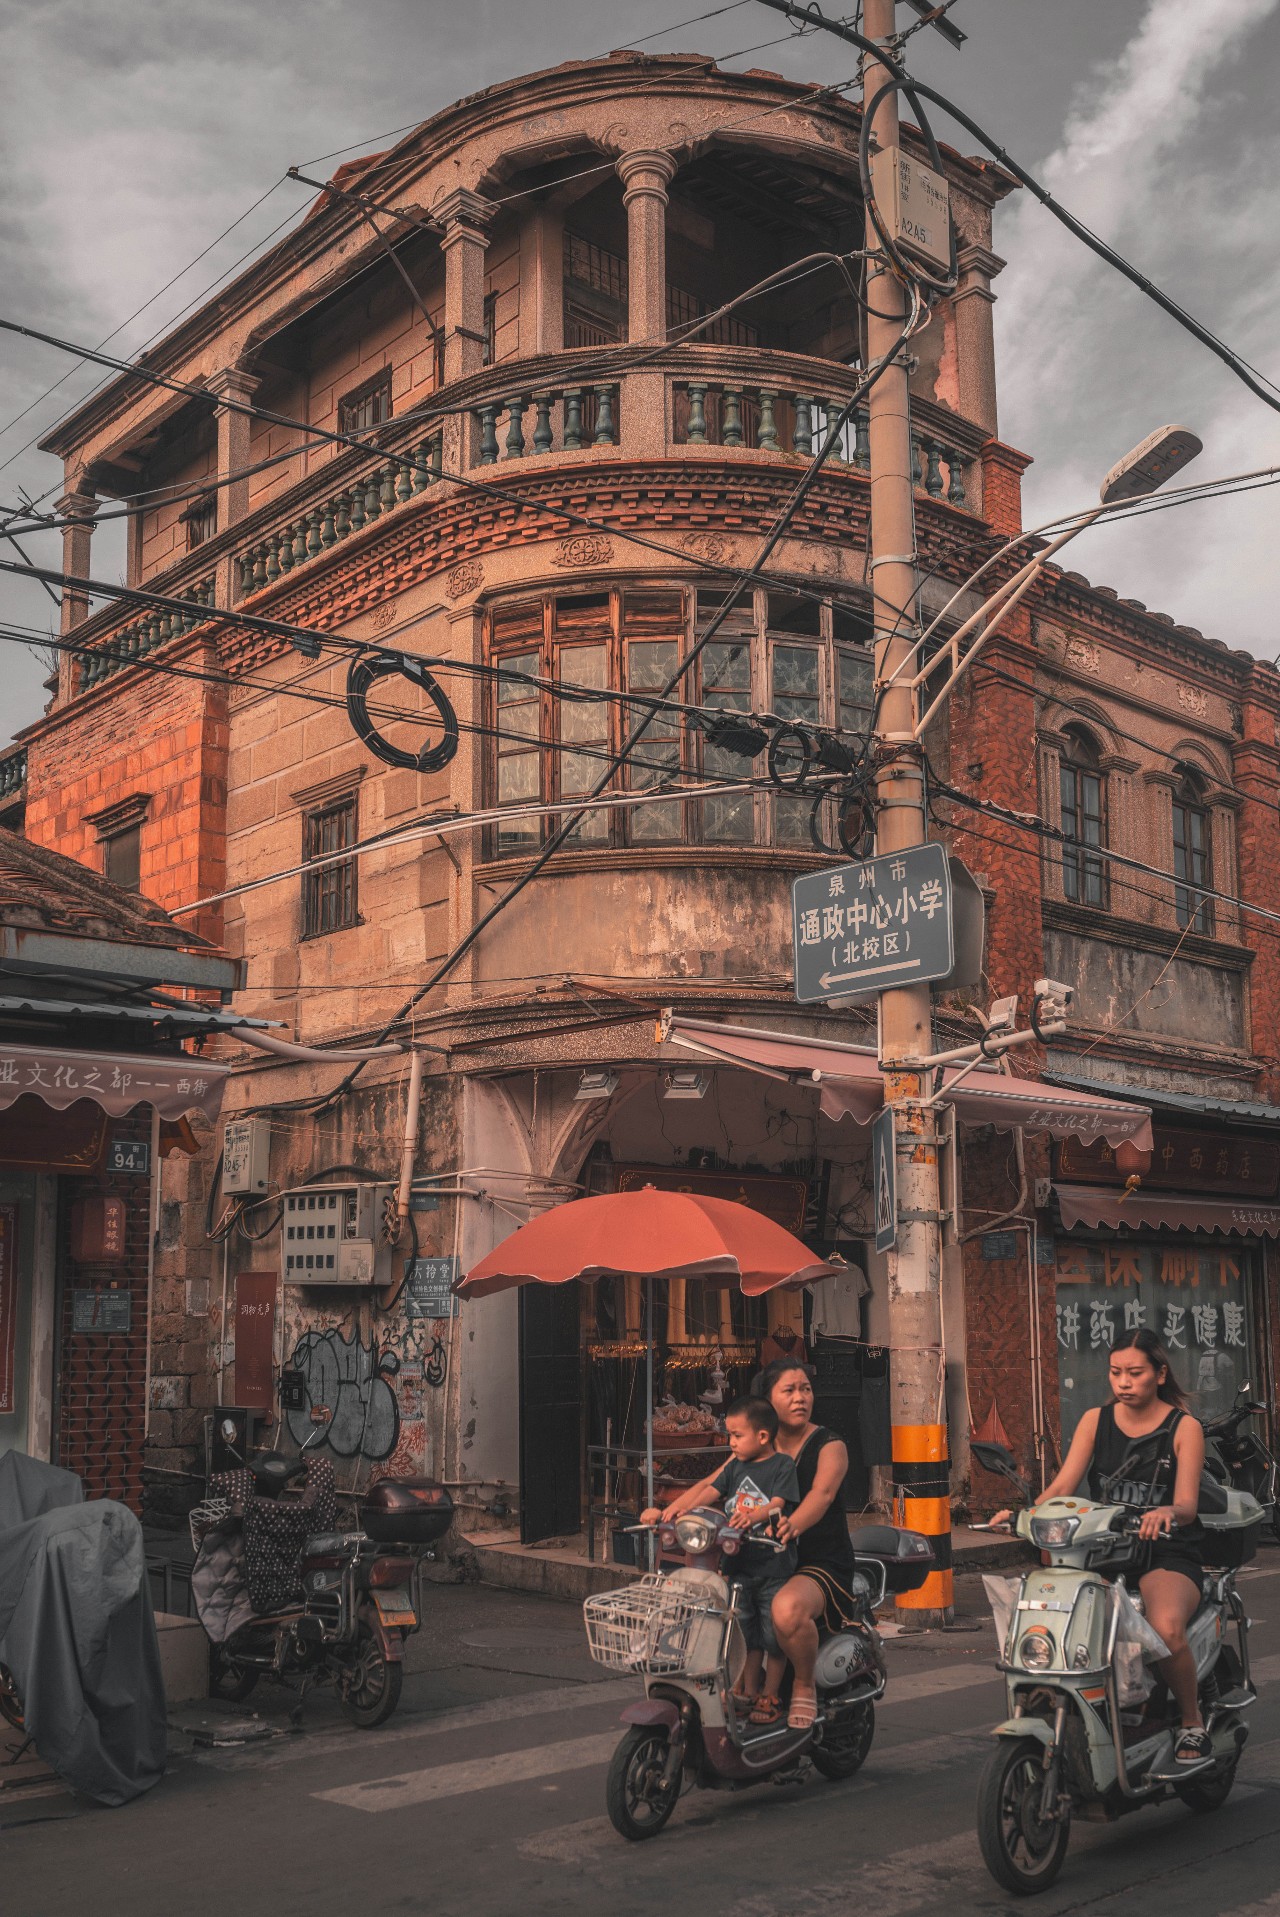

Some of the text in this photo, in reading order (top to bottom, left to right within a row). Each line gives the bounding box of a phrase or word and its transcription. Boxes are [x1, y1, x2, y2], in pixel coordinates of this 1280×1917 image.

[901, 217, 926, 244] A2A5
[828, 859, 907, 898] 泉州市
[799, 878, 944, 947] 通政中心小学
[831, 930, 911, 967] （北校区）
[114, 1153, 135, 1169] 94
[104, 1207, 119, 1251] 华佳眼镜
